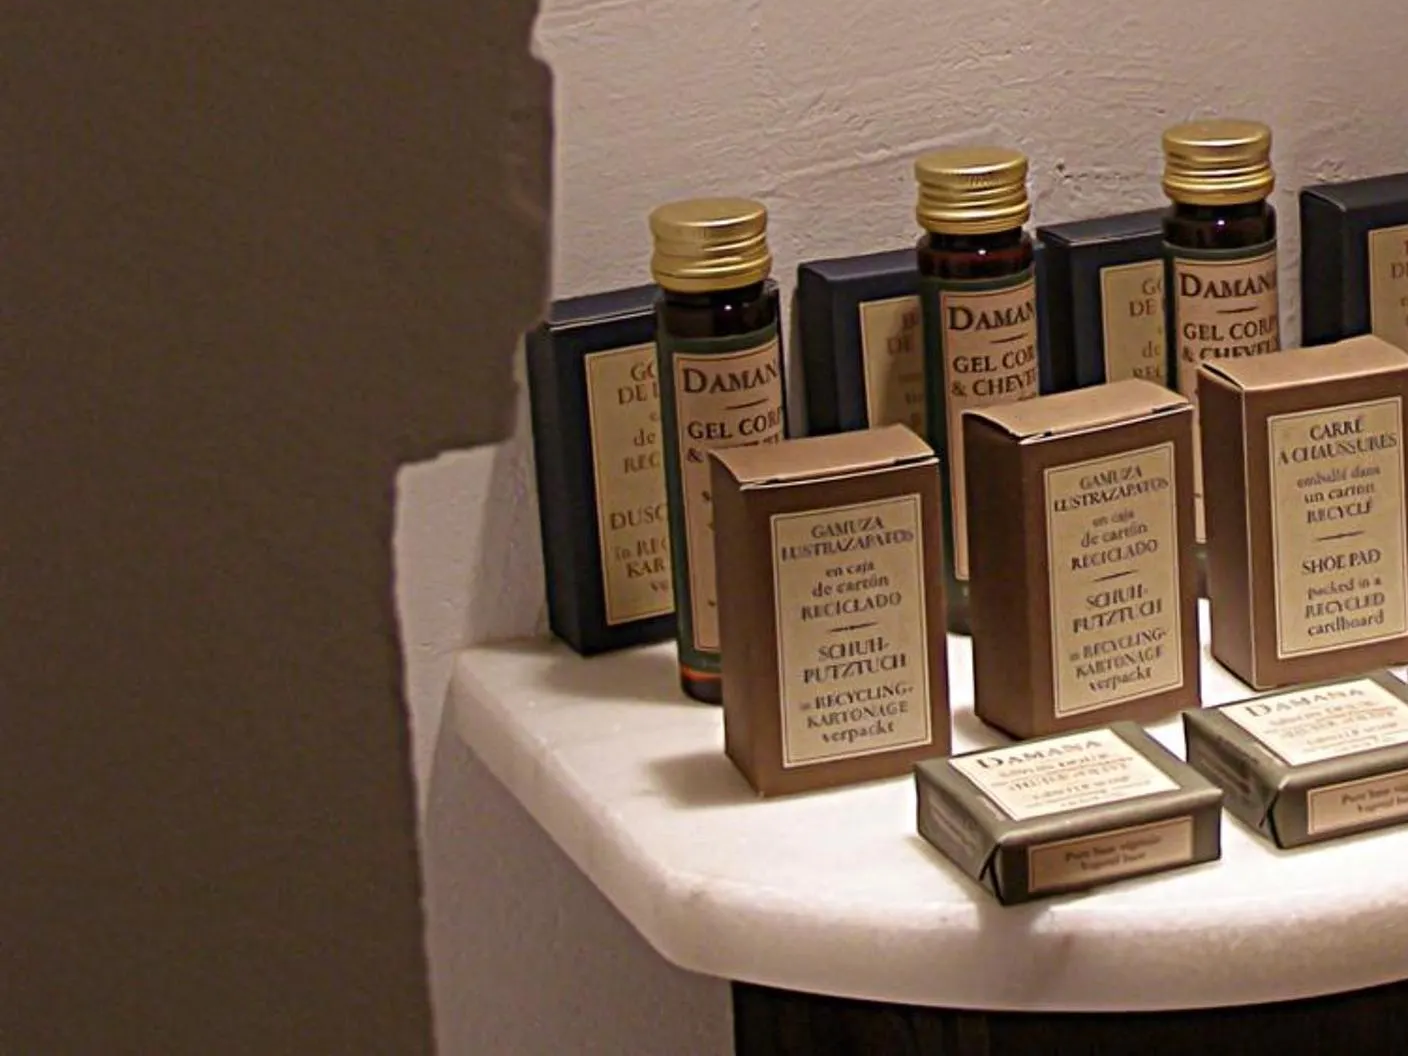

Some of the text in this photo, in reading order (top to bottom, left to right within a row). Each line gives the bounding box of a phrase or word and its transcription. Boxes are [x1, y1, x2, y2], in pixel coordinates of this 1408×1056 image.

[1129, 299, 1157, 317] DE
[1184, 323, 1224, 341] GEL
[953, 356, 997, 374] GEL
[952, 380, 967, 397] &
[687, 420, 733, 440] GEL
[687, 447, 703, 463] &
[1328, 483, 1375, 500] carton
[811, 516, 884, 539] GAMUZA
[1071, 539, 1158, 570] RECICLADO
[1302, 548, 1381, 575] SHOE PAD
[825, 566, 842, 578] en
[812, 581, 833, 597] de
[801, 591, 902, 622] RECICLADO
[1305, 592, 1385, 619] RECYCLED
[1308, 609, 1385, 636] cardboard
[803, 654, 906, 684] PUTZTUCH
[1245, 688, 1365, 717] DAMANA
[807, 701, 908, 729] KARTONAGE
[822, 719, 895, 743] verpackt
[976, 739, 1103, 768] DAMANA
